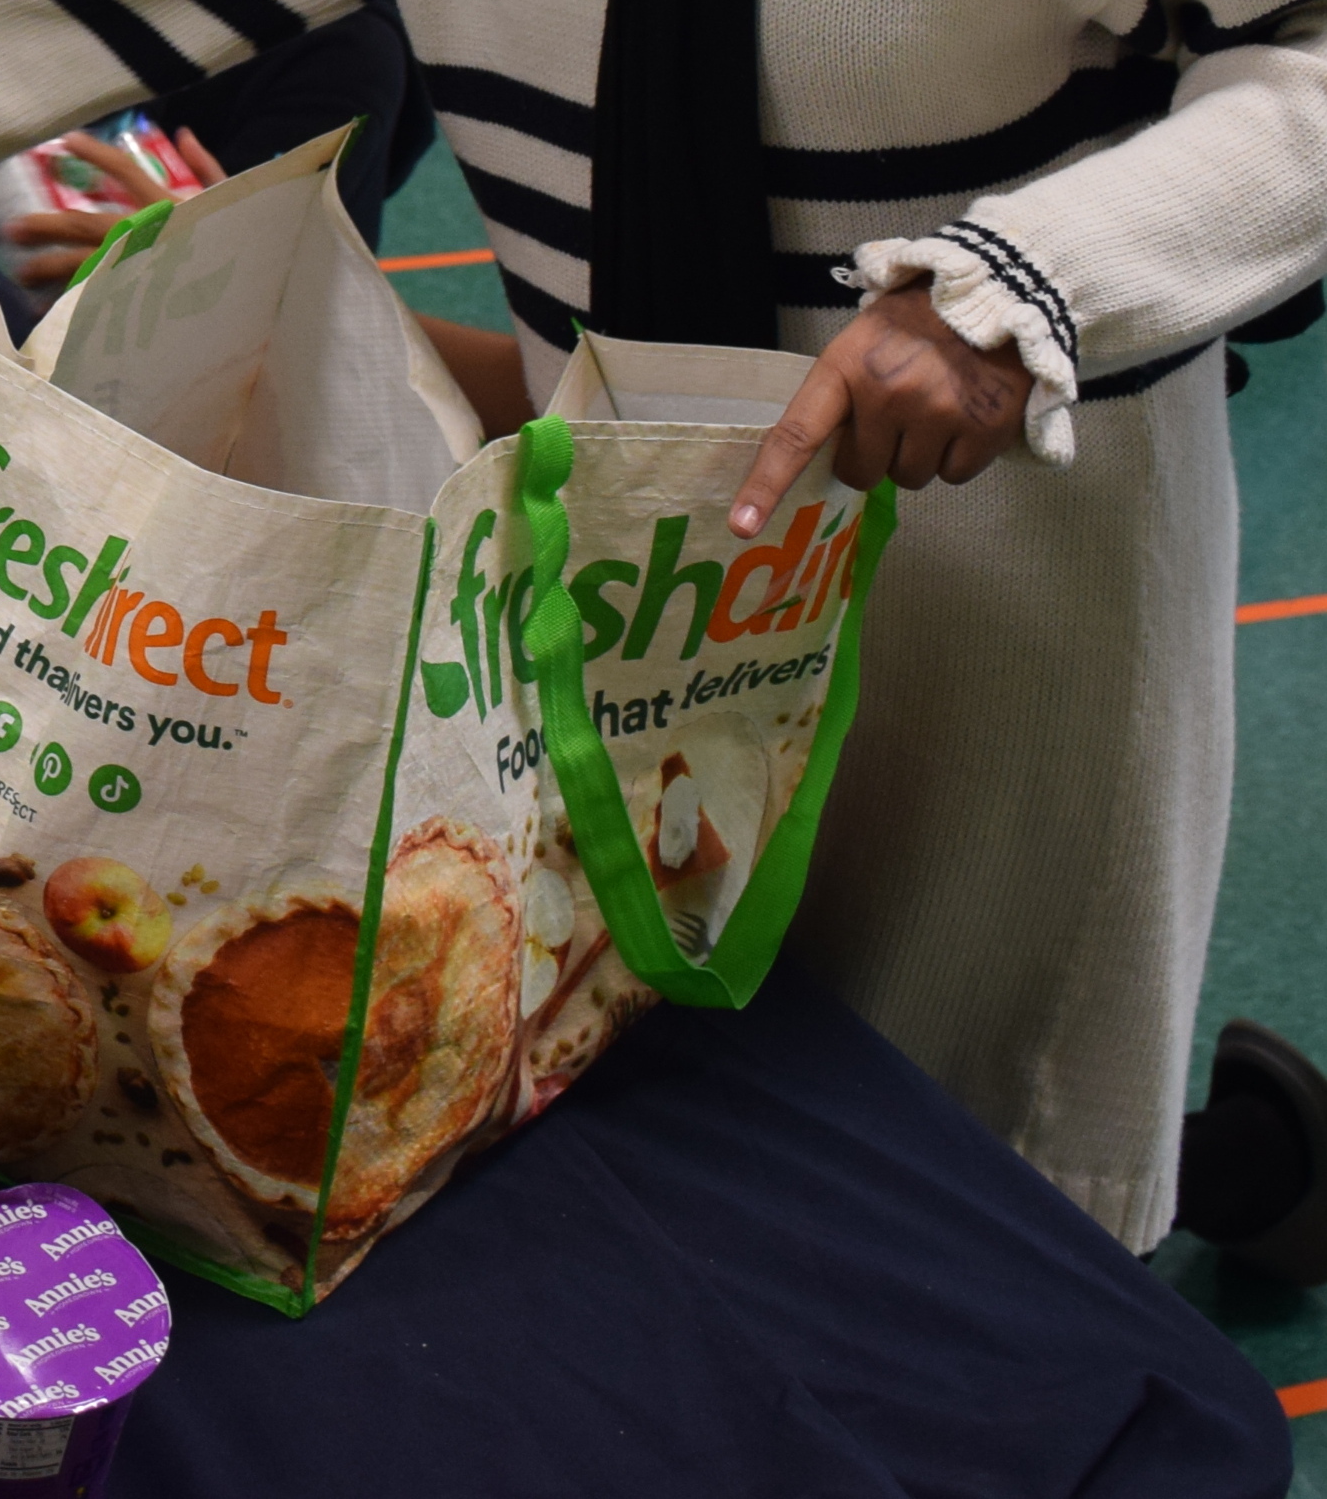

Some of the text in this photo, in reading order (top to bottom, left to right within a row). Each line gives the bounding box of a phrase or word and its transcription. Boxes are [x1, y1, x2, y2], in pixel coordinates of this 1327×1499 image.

[496, 733, 547, 794] Foo
[592, 690, 674, 739] hat
[39, 1219, 123, 1262] Annie
[24, 1268, 118, 1318] Annie's
[5, 1322, 102, 1376] Annie's
[93, 1335, 170, 1386] Annie
